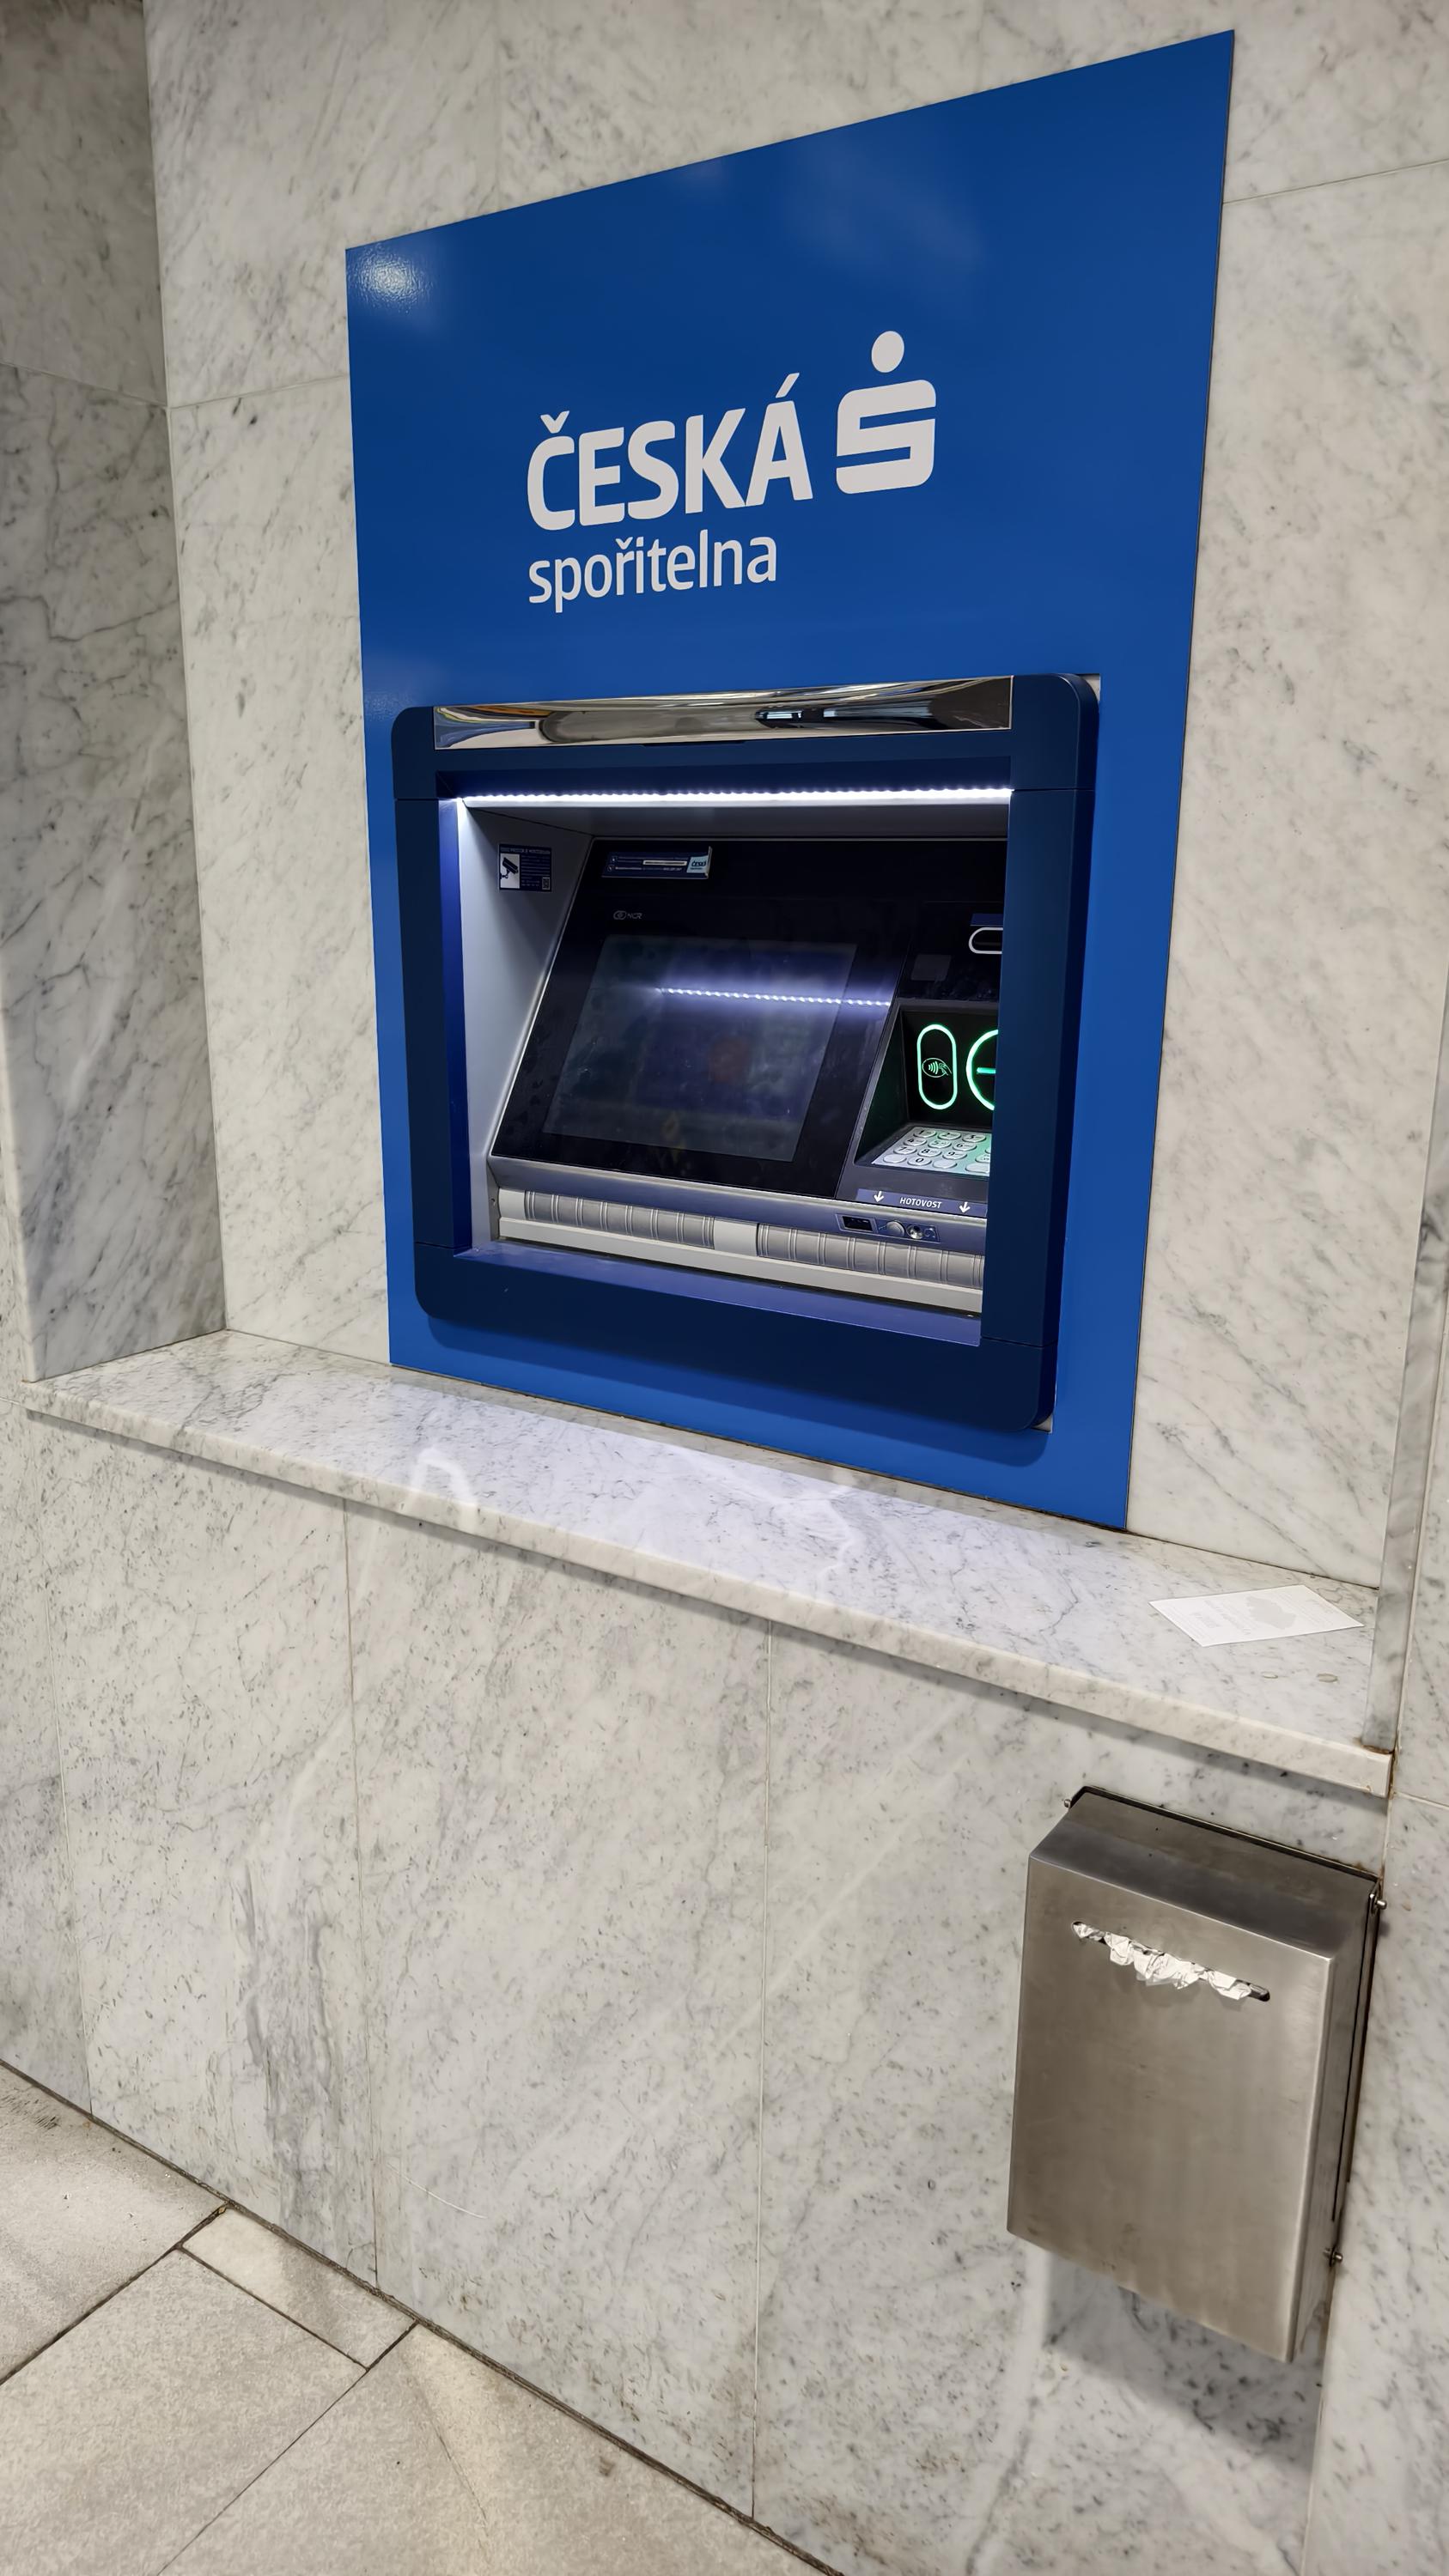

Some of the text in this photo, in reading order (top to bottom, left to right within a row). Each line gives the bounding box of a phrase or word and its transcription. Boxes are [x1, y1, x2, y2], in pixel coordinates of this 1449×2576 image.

[527, 373, 813, 531] ČESKÁ
[529, 530, 776, 613] spořitelna
[899, 1197, 942, 1209] HOTOVOST
